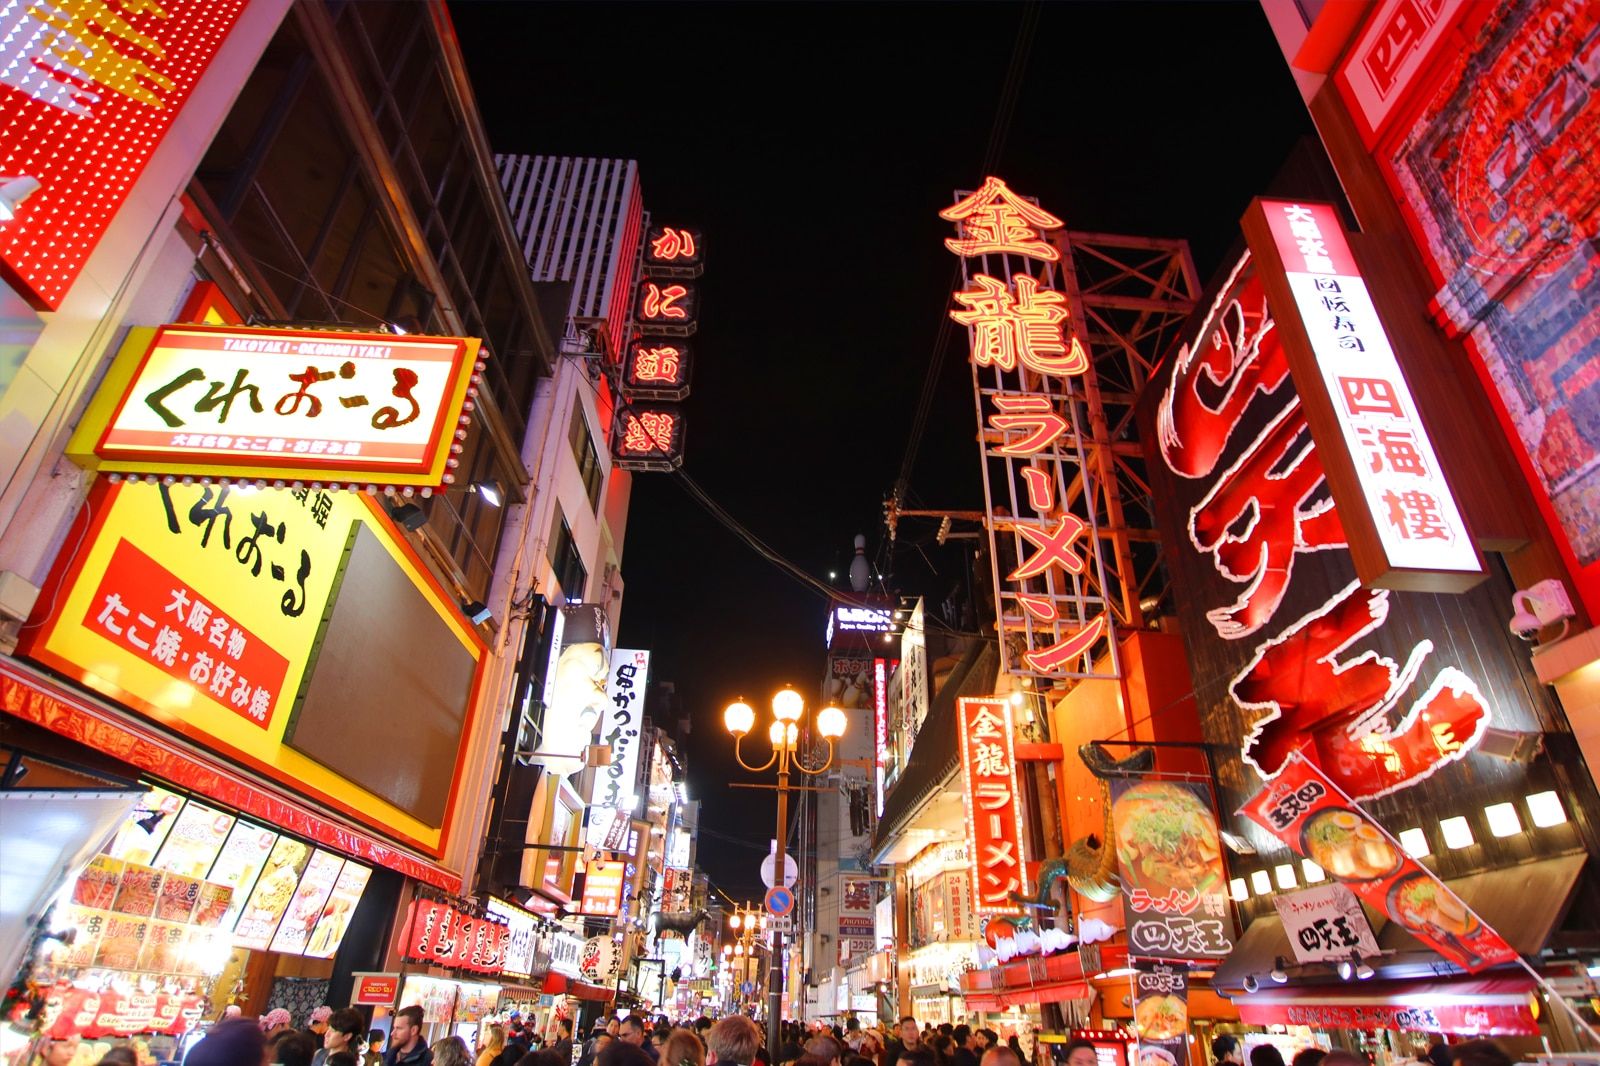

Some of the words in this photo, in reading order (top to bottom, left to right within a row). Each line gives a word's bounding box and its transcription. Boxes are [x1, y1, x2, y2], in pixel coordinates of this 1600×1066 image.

[1313, 277, 1366, 352] 回転寿司
[145, 361, 421, 430] くれおーる
[939, 176, 1107, 674] 金龍ラーメン
[1338, 375, 1450, 541] 四海樓
[165, 588, 247, 661] 大阪名物
[602, 662, 638, 808] 串かつだるま
[968, 704, 1021, 904] 金龍ラーメン
[1130, 887, 1201, 917] ラーメン
[1131, 916, 1234, 955] 四天王
[1297, 915, 1360, 953] 四天王
[852, 940, 875, 950] コクミン
[1139, 972, 1185, 992] 四天王
[1395, 1005, 1440, 1031] 四天王
